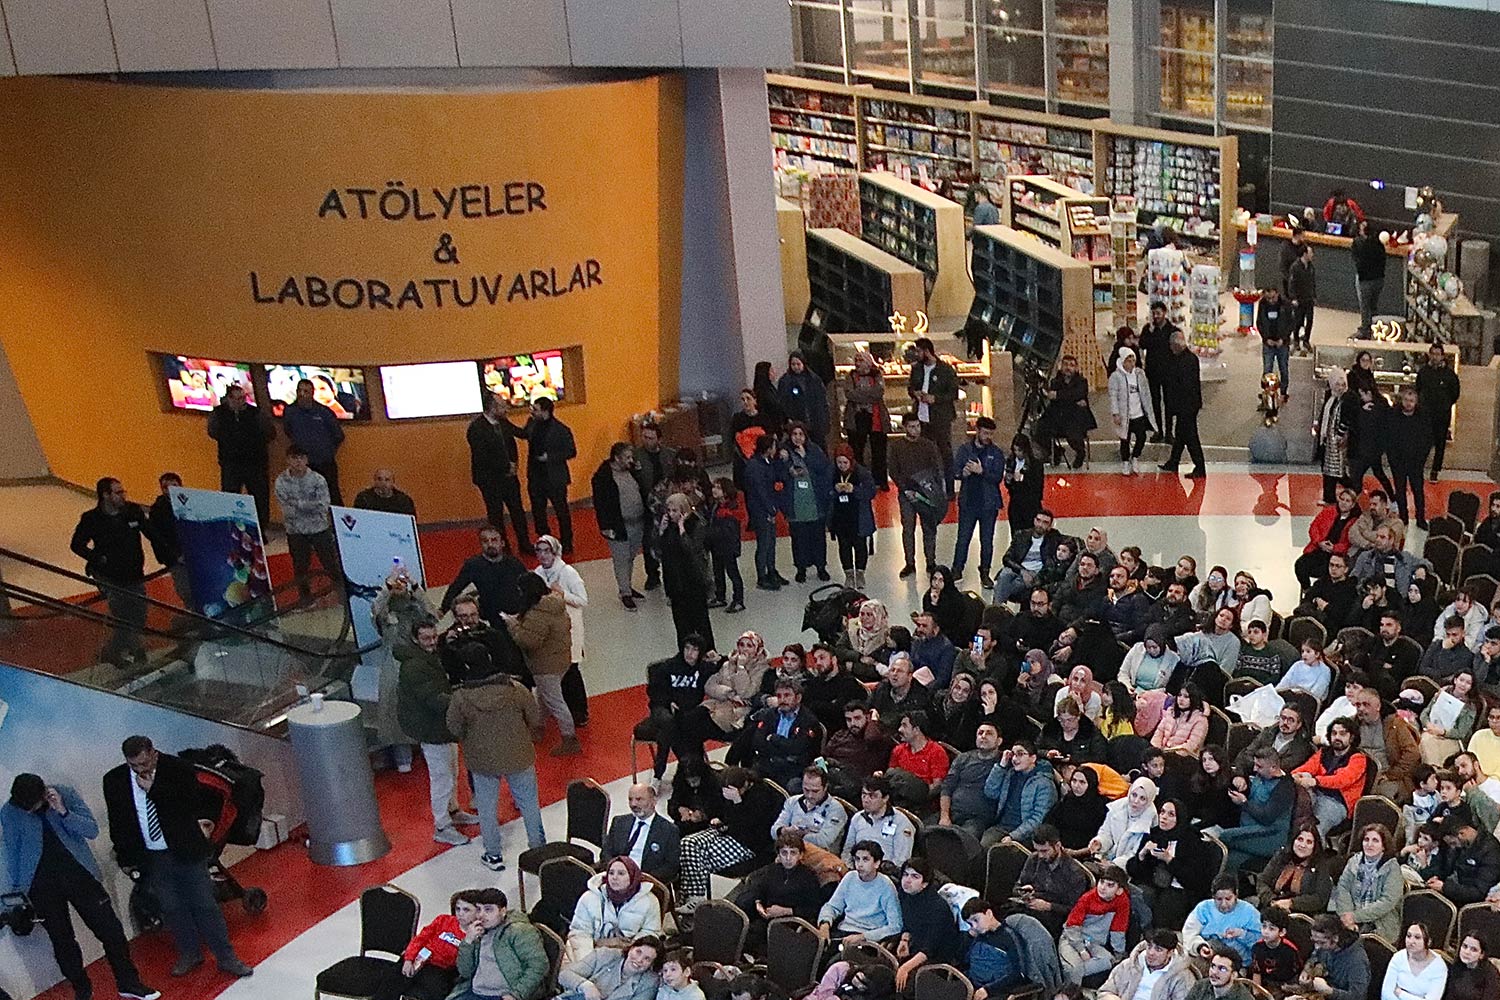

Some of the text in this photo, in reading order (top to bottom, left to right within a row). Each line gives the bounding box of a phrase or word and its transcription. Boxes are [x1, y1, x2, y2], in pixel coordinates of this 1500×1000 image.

[318, 180, 548, 221] ATÖLYELER
[432, 232, 461, 265] &
[250, 259, 603, 309] LABORATUVARLAR
